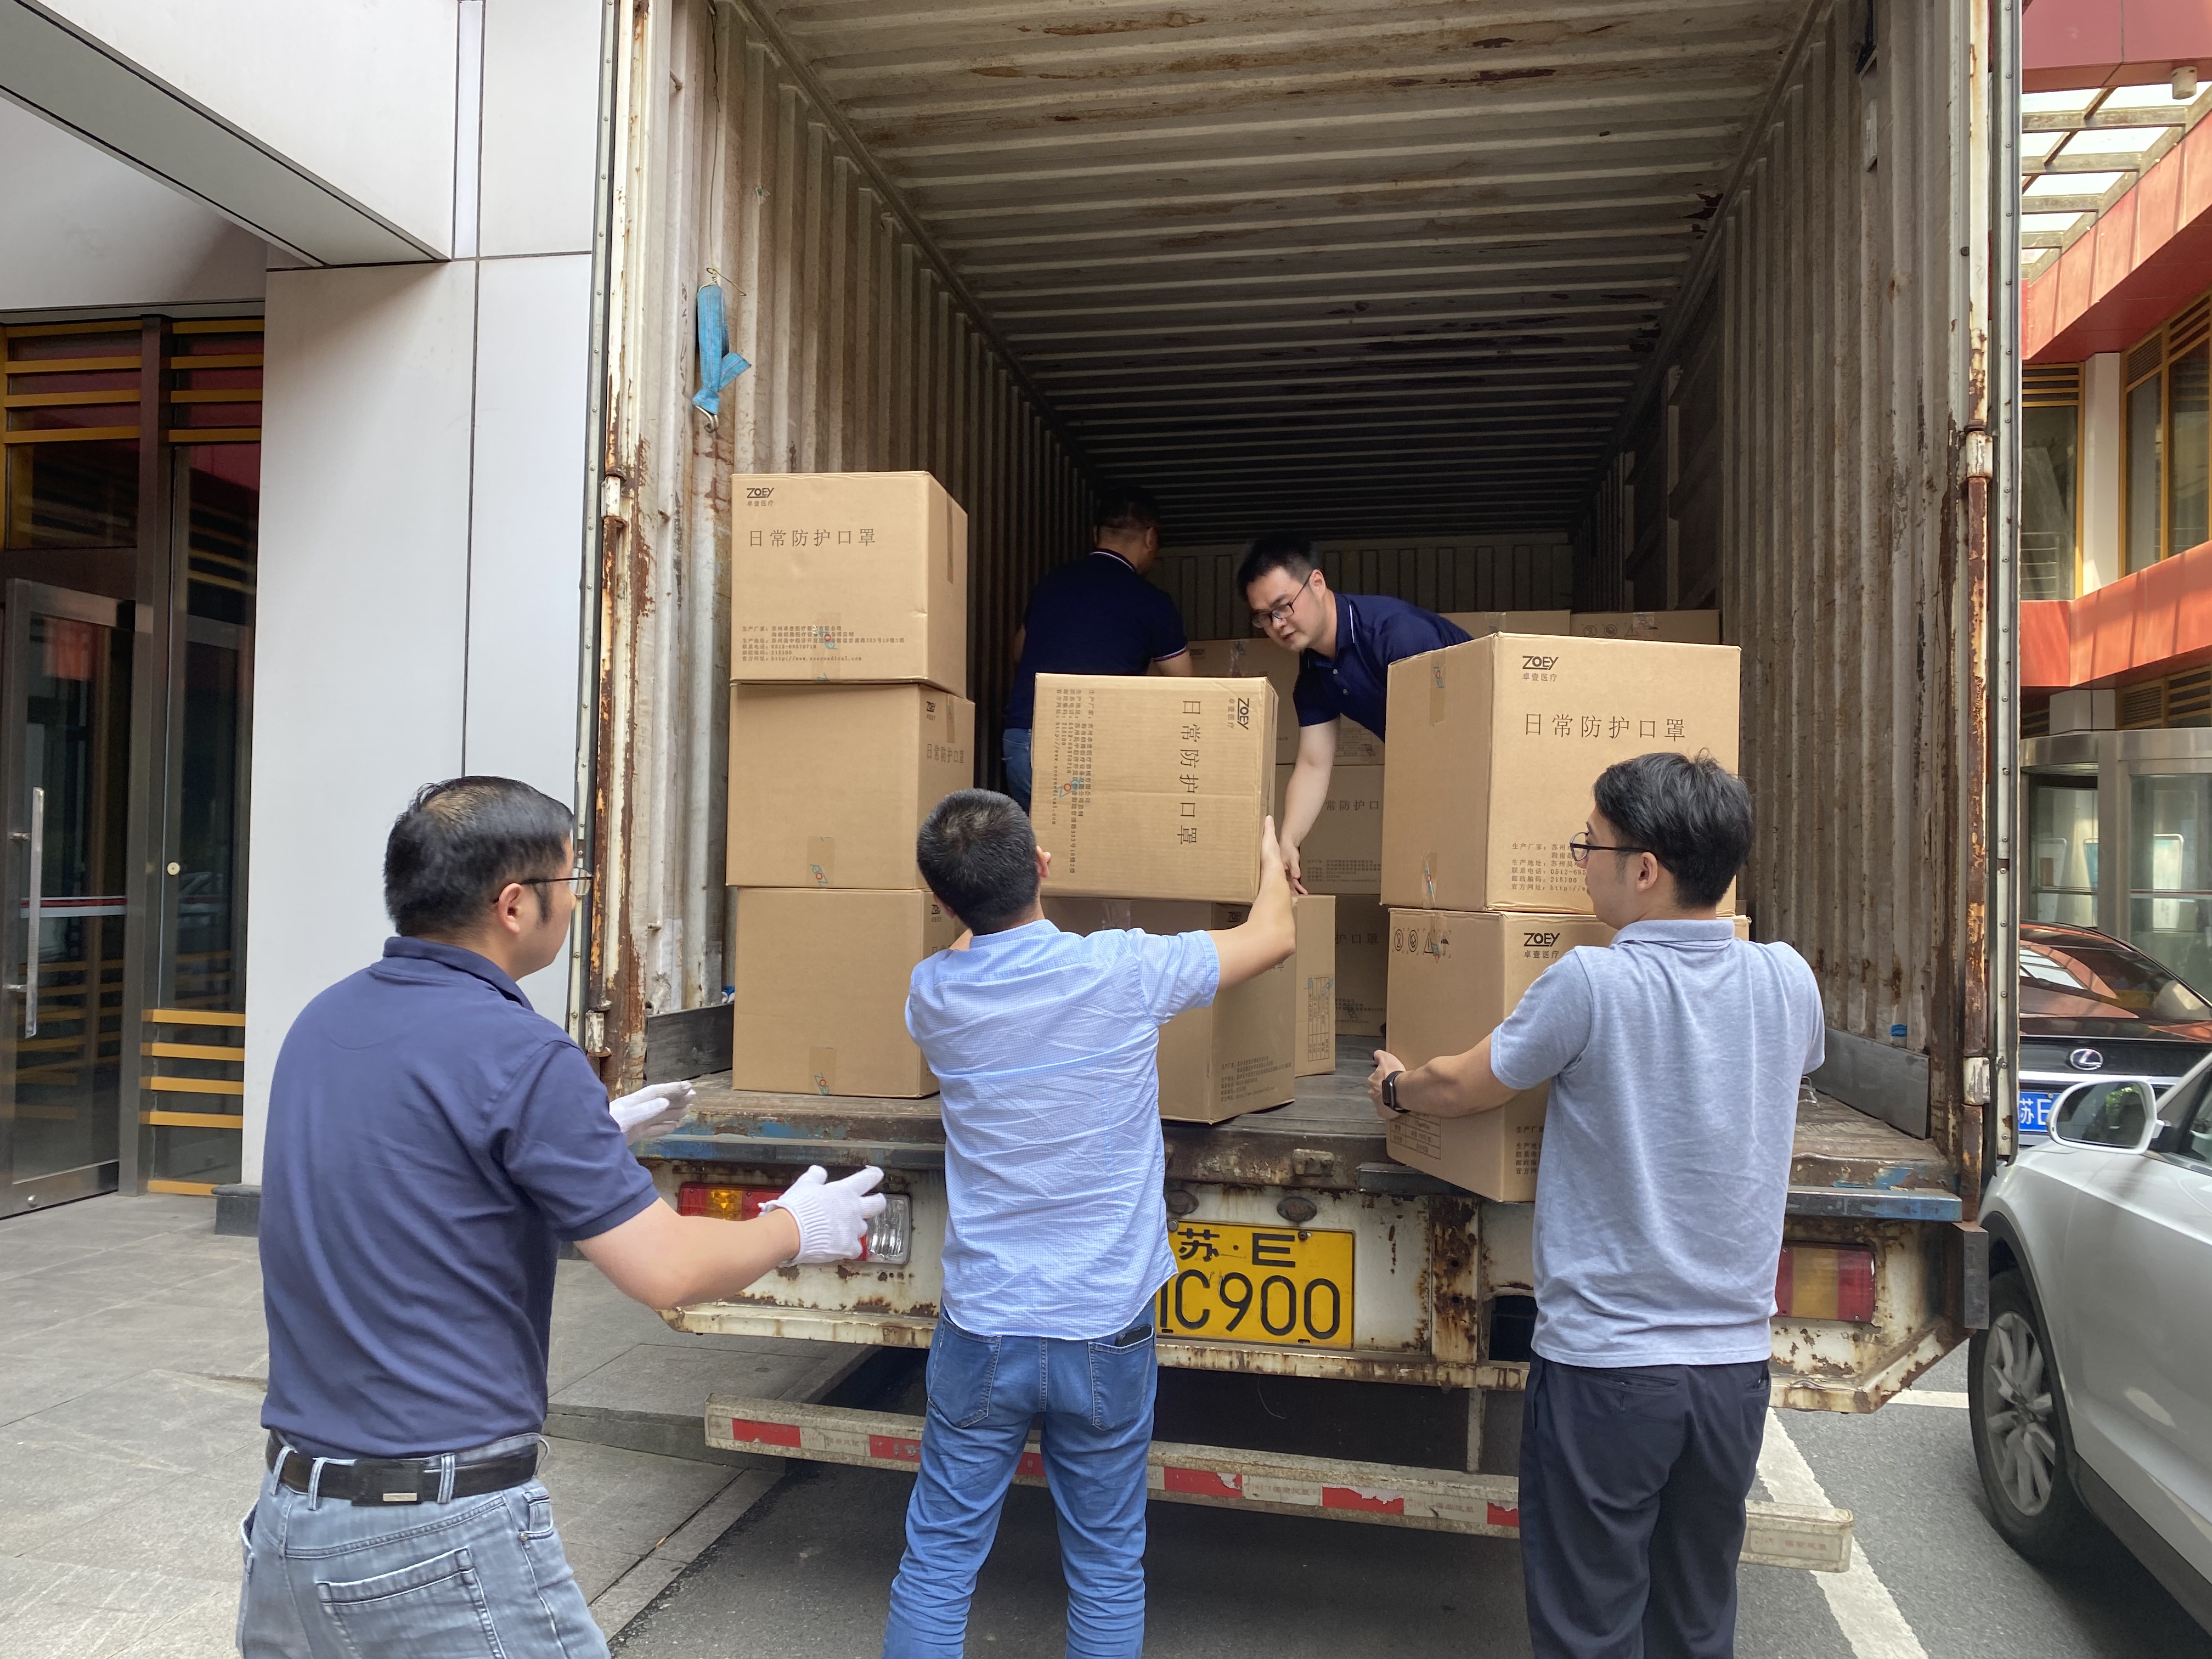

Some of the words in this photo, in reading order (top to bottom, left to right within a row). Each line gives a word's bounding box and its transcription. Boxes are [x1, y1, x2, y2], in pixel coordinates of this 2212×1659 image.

[747, 487, 775, 498] ZOEY
[749, 528, 876, 548] 日常防护口罩
[1522, 655, 1559, 670] ZOEY
[1522, 673, 1558, 682] 卓壹医疗
[1237, 697, 1250, 731] ZOEY
[1525, 713, 1686, 742] 日常防护口罩
[1177, 700, 1201, 845] 日常防护口罩
[1523, 933, 1561, 947] ZOEY
[1523, 950, 1559, 959] 卓壹医疗
[1160, 1269, 1340, 1340] C900
